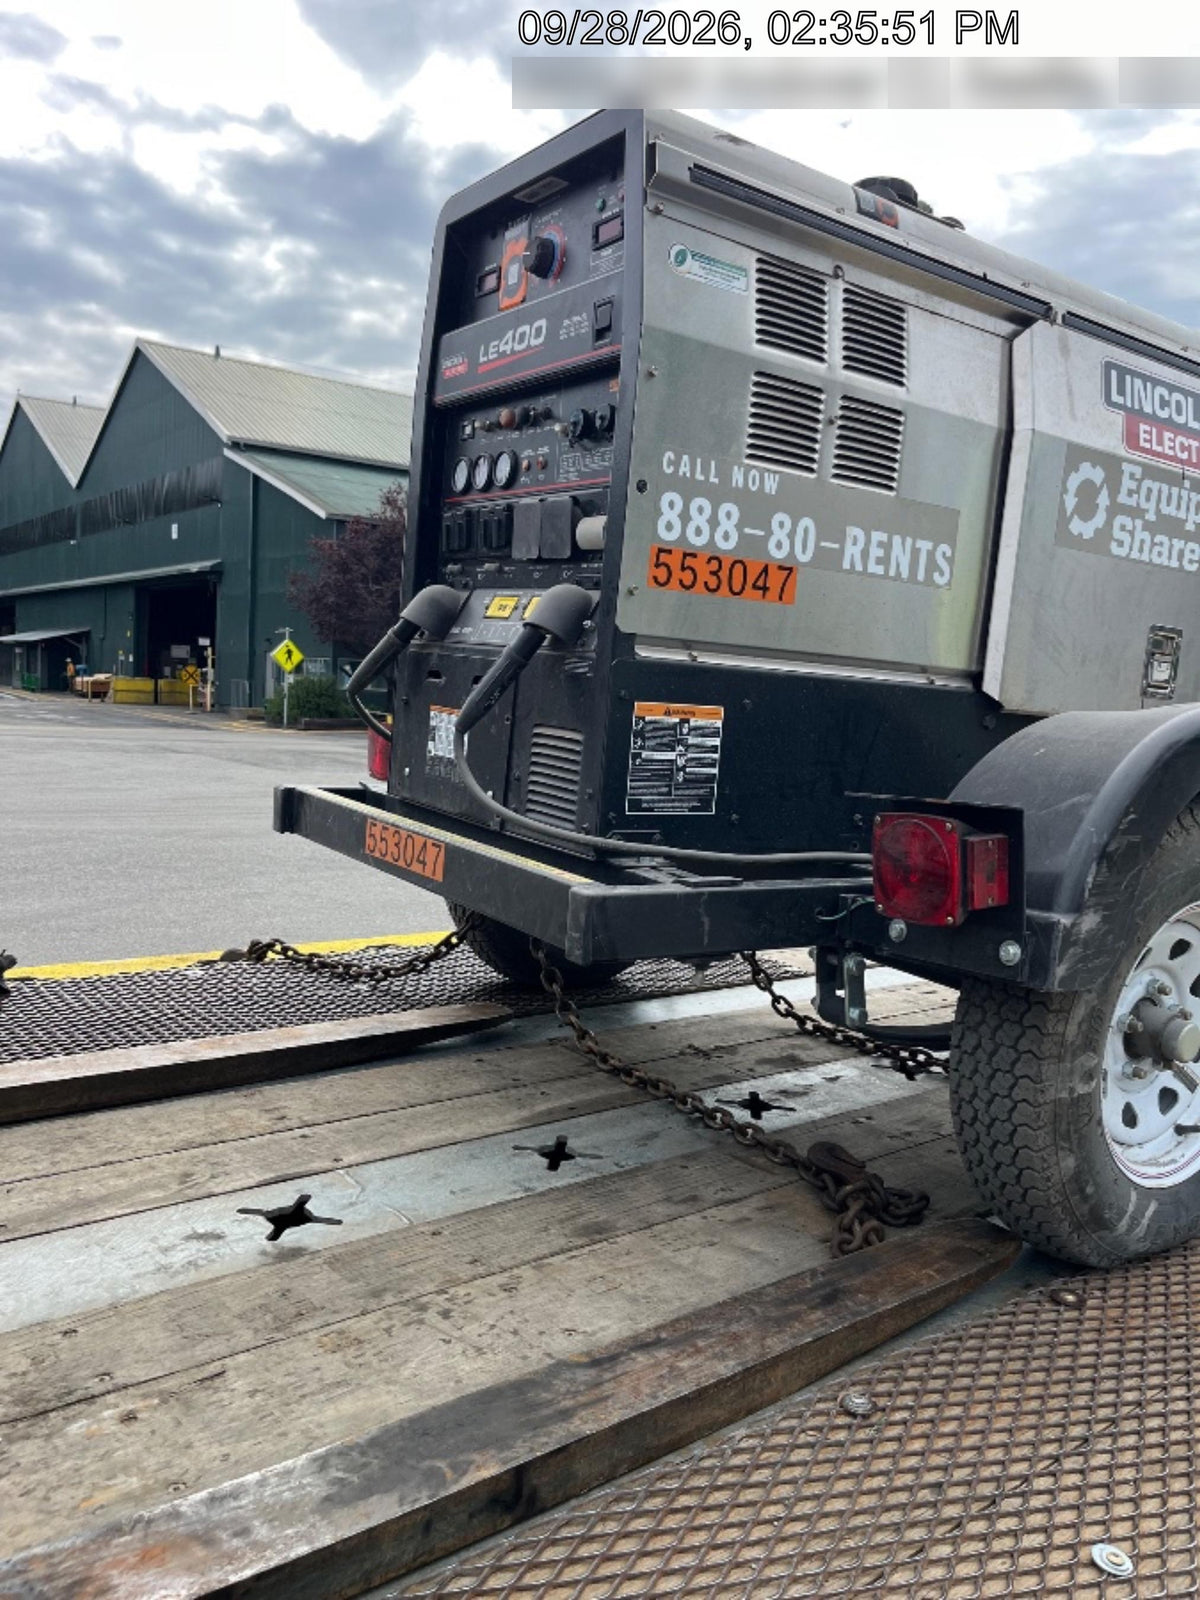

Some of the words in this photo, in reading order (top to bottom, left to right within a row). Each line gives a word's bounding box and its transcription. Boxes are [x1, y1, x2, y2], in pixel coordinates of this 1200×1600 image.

[479, 318, 547, 363] LE400
[1138, 422, 1199, 463] ELECT
[662, 451, 719, 484] CALL
[731, 465, 780, 495] NOW
[657, 491, 952, 586] 888-80-RENTS
[1110, 514, 1200, 572] Share
[652, 548, 794, 602] 553047
[367, 821, 442, 877] 553047
